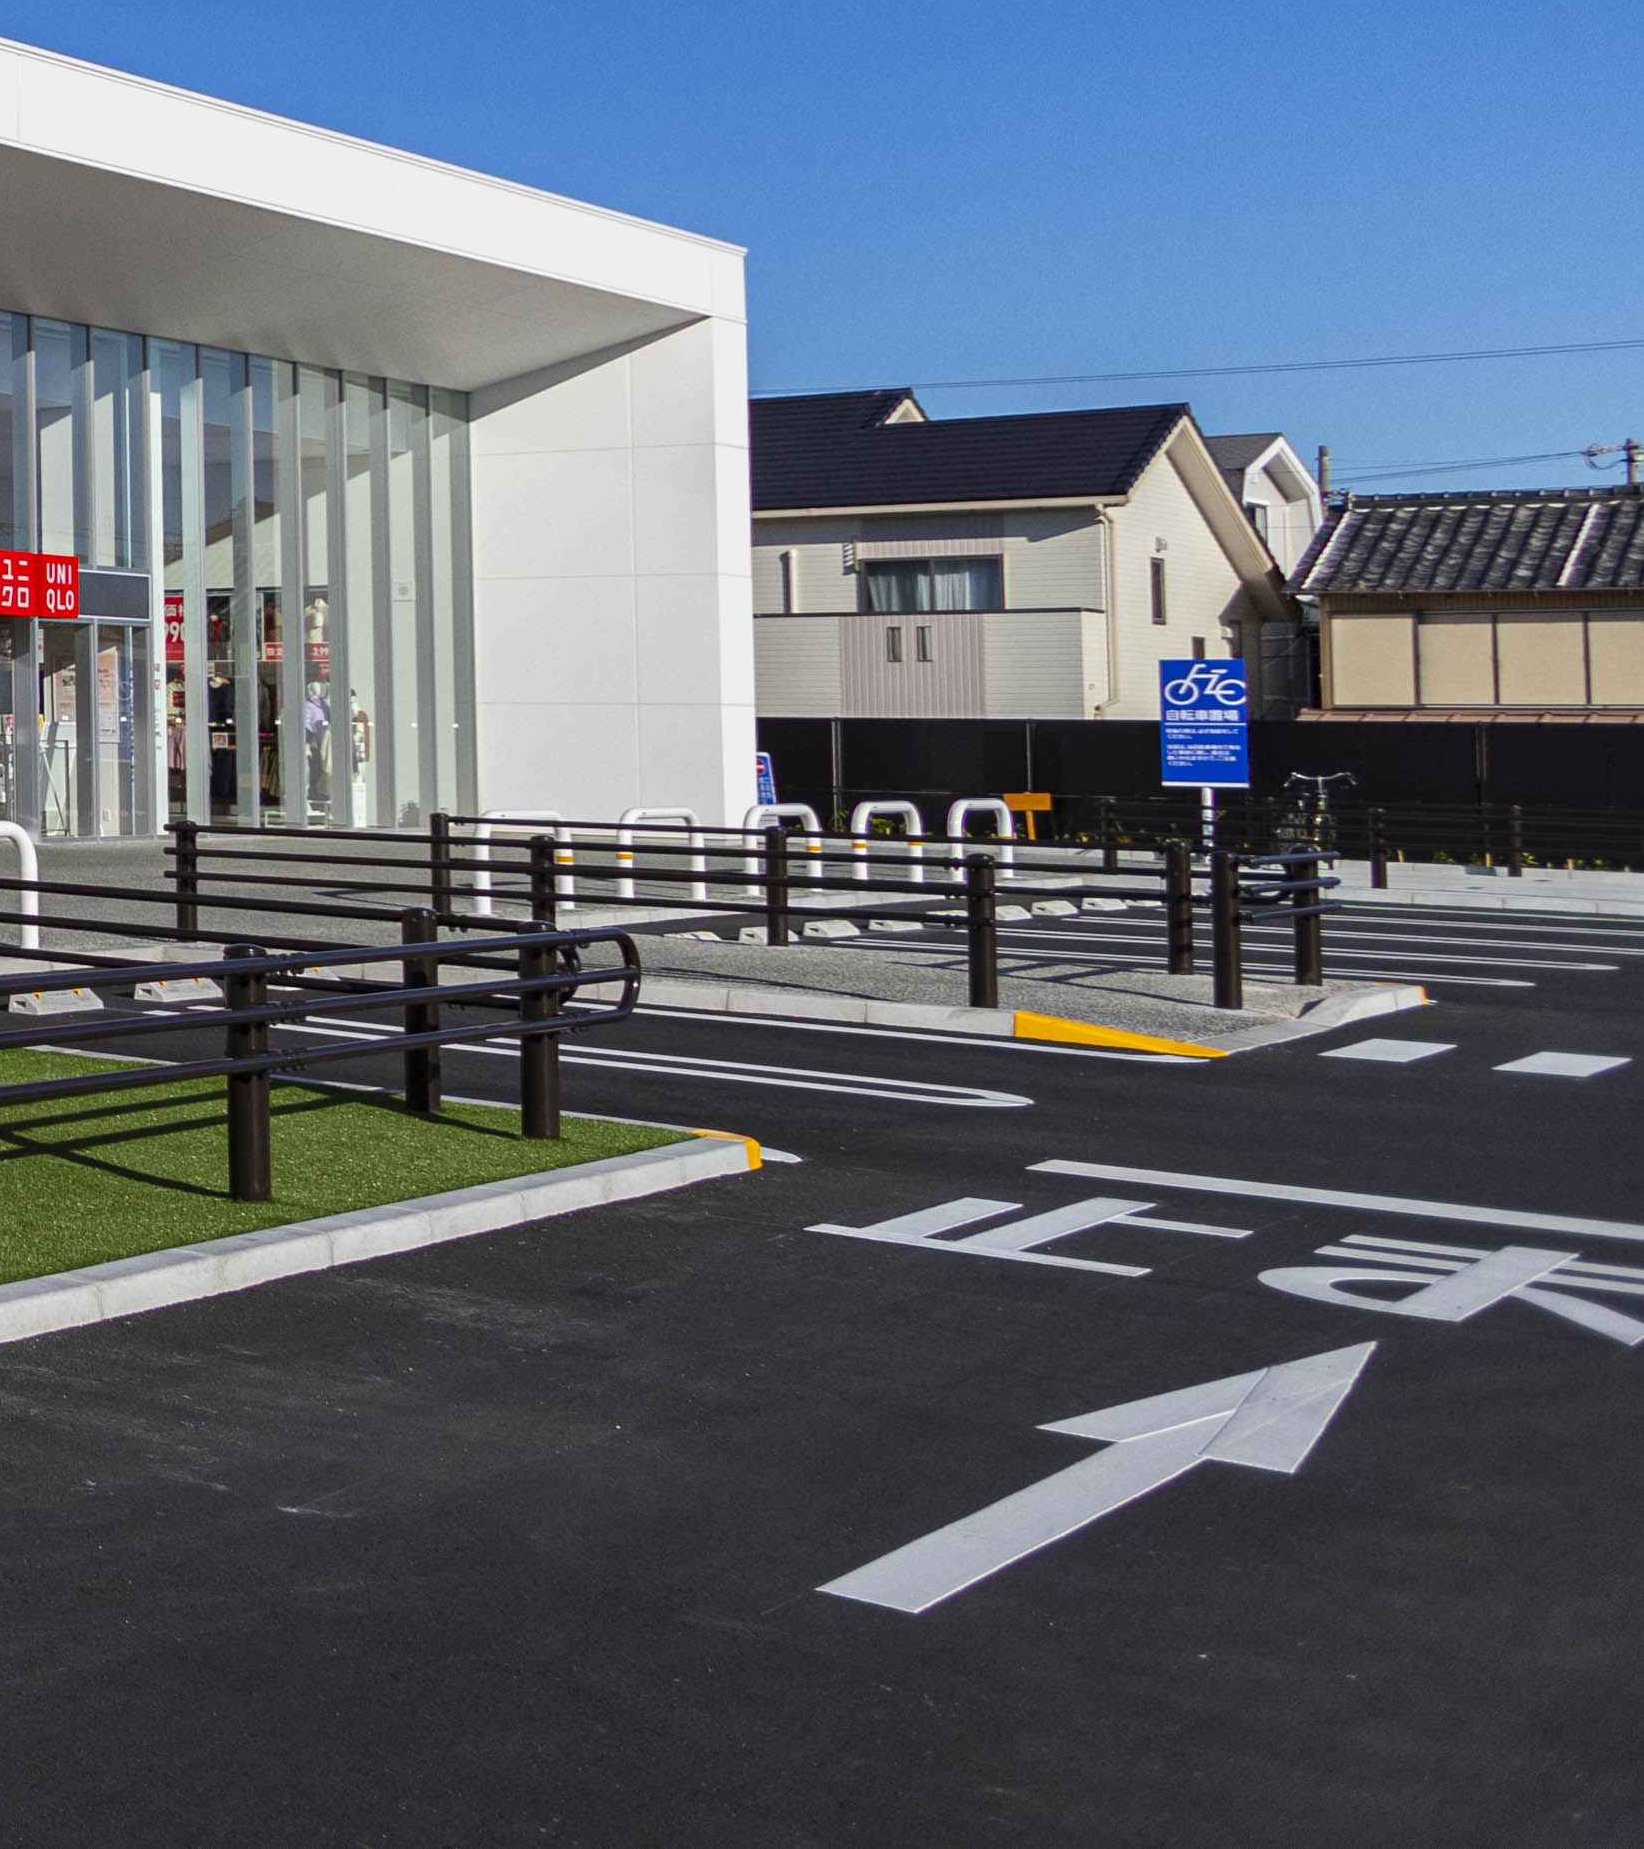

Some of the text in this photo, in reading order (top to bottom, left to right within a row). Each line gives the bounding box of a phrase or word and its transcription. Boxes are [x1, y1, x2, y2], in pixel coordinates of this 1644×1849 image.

[1, 558, 29, 582] ユニ
[46, 562, 73, 585] UNI
[1, 585, 30, 608] クロ
[46, 588, 75, 613] QLO
